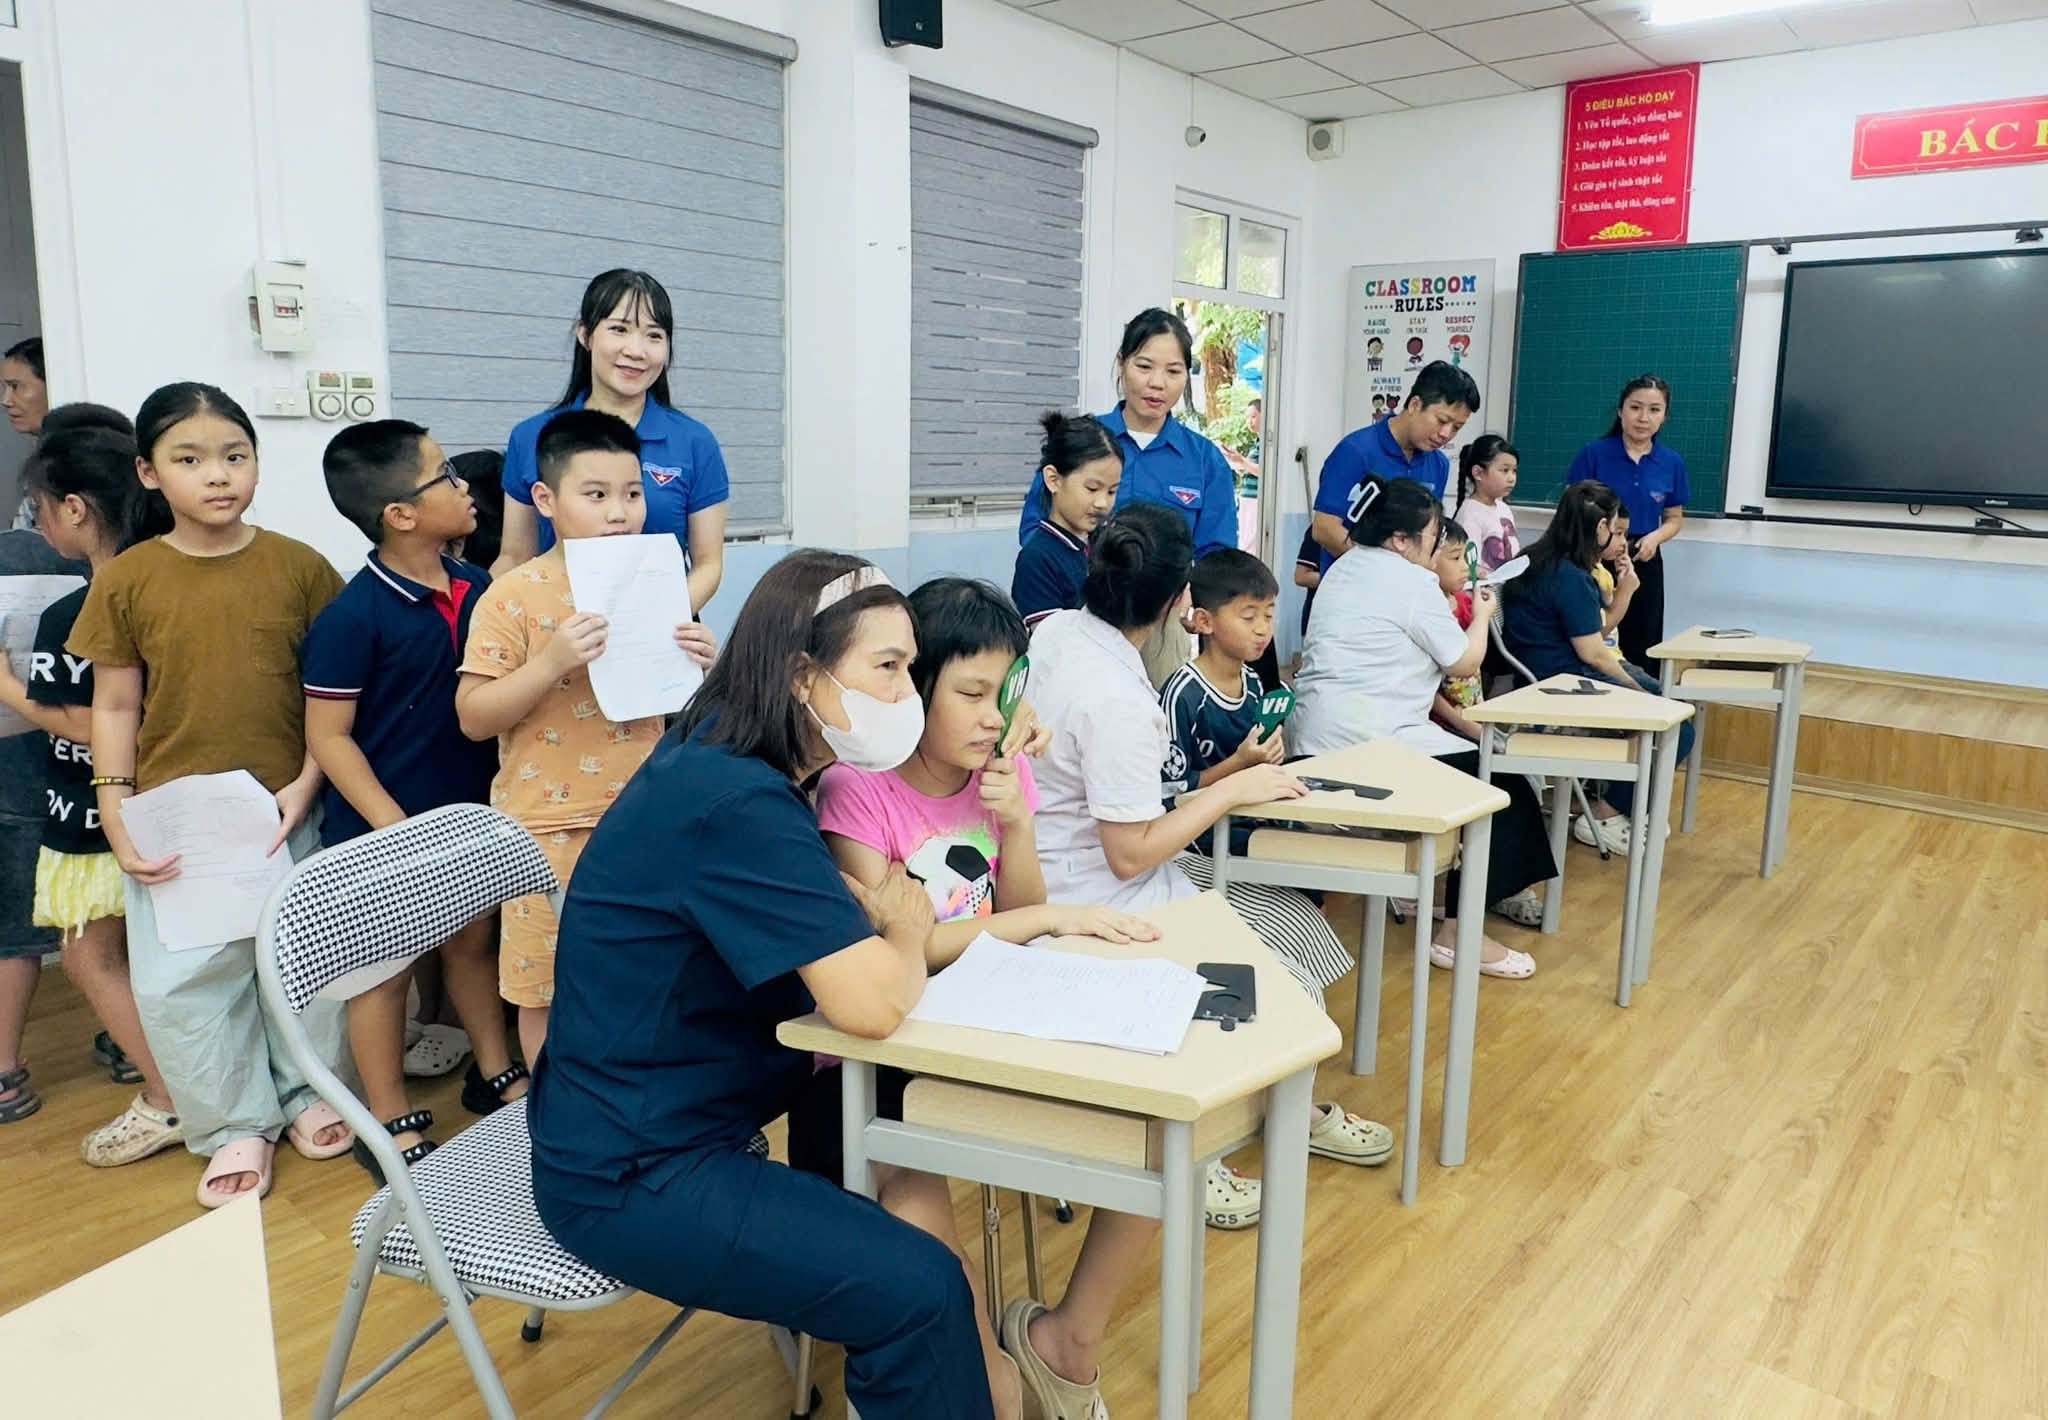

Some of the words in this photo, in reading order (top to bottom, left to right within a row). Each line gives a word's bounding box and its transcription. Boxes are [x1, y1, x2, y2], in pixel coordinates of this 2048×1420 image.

[1616, 95, 1636, 107] BÁC
[1919, 118, 2020, 157] BÁC
[1365, 275, 1477, 297] CLASSROOM
[1394, 296, 1445, 312] RULES
[1262, 697, 1289, 715] VH
